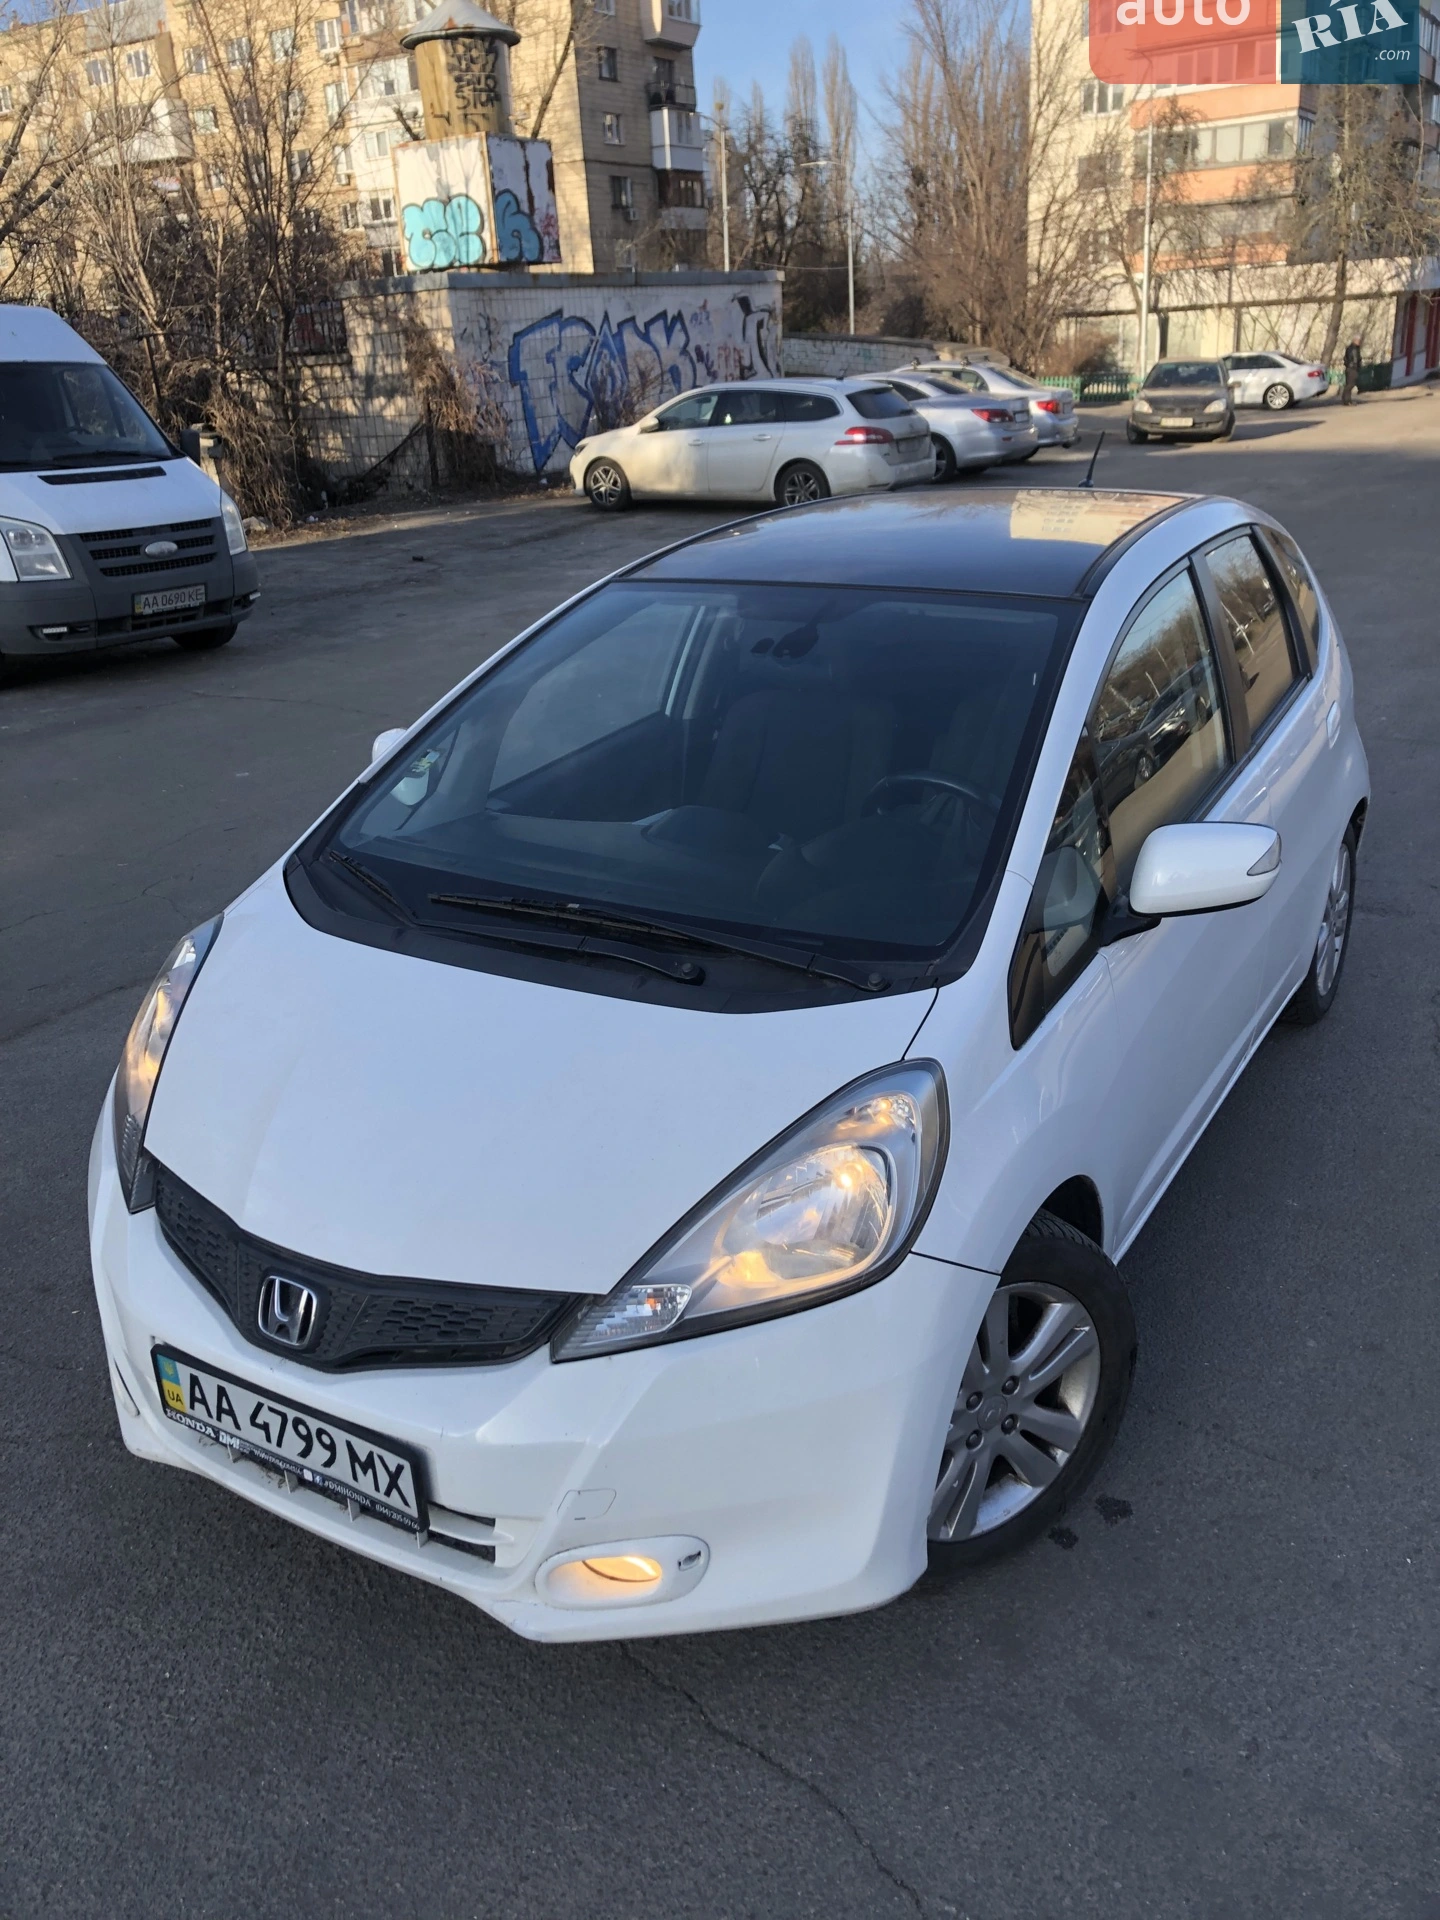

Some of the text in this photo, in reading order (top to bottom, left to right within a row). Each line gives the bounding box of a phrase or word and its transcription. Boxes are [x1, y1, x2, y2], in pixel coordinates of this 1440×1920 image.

[143, 588, 204, 610] AA 0690 KE
[167, 1389, 184, 1406] UA
[165, 1408, 216, 1438] HONDA
[189, 1373, 241, 1431] AA
[250, 1401, 337, 1468] 4799
[345, 1439, 412, 1508] MX
